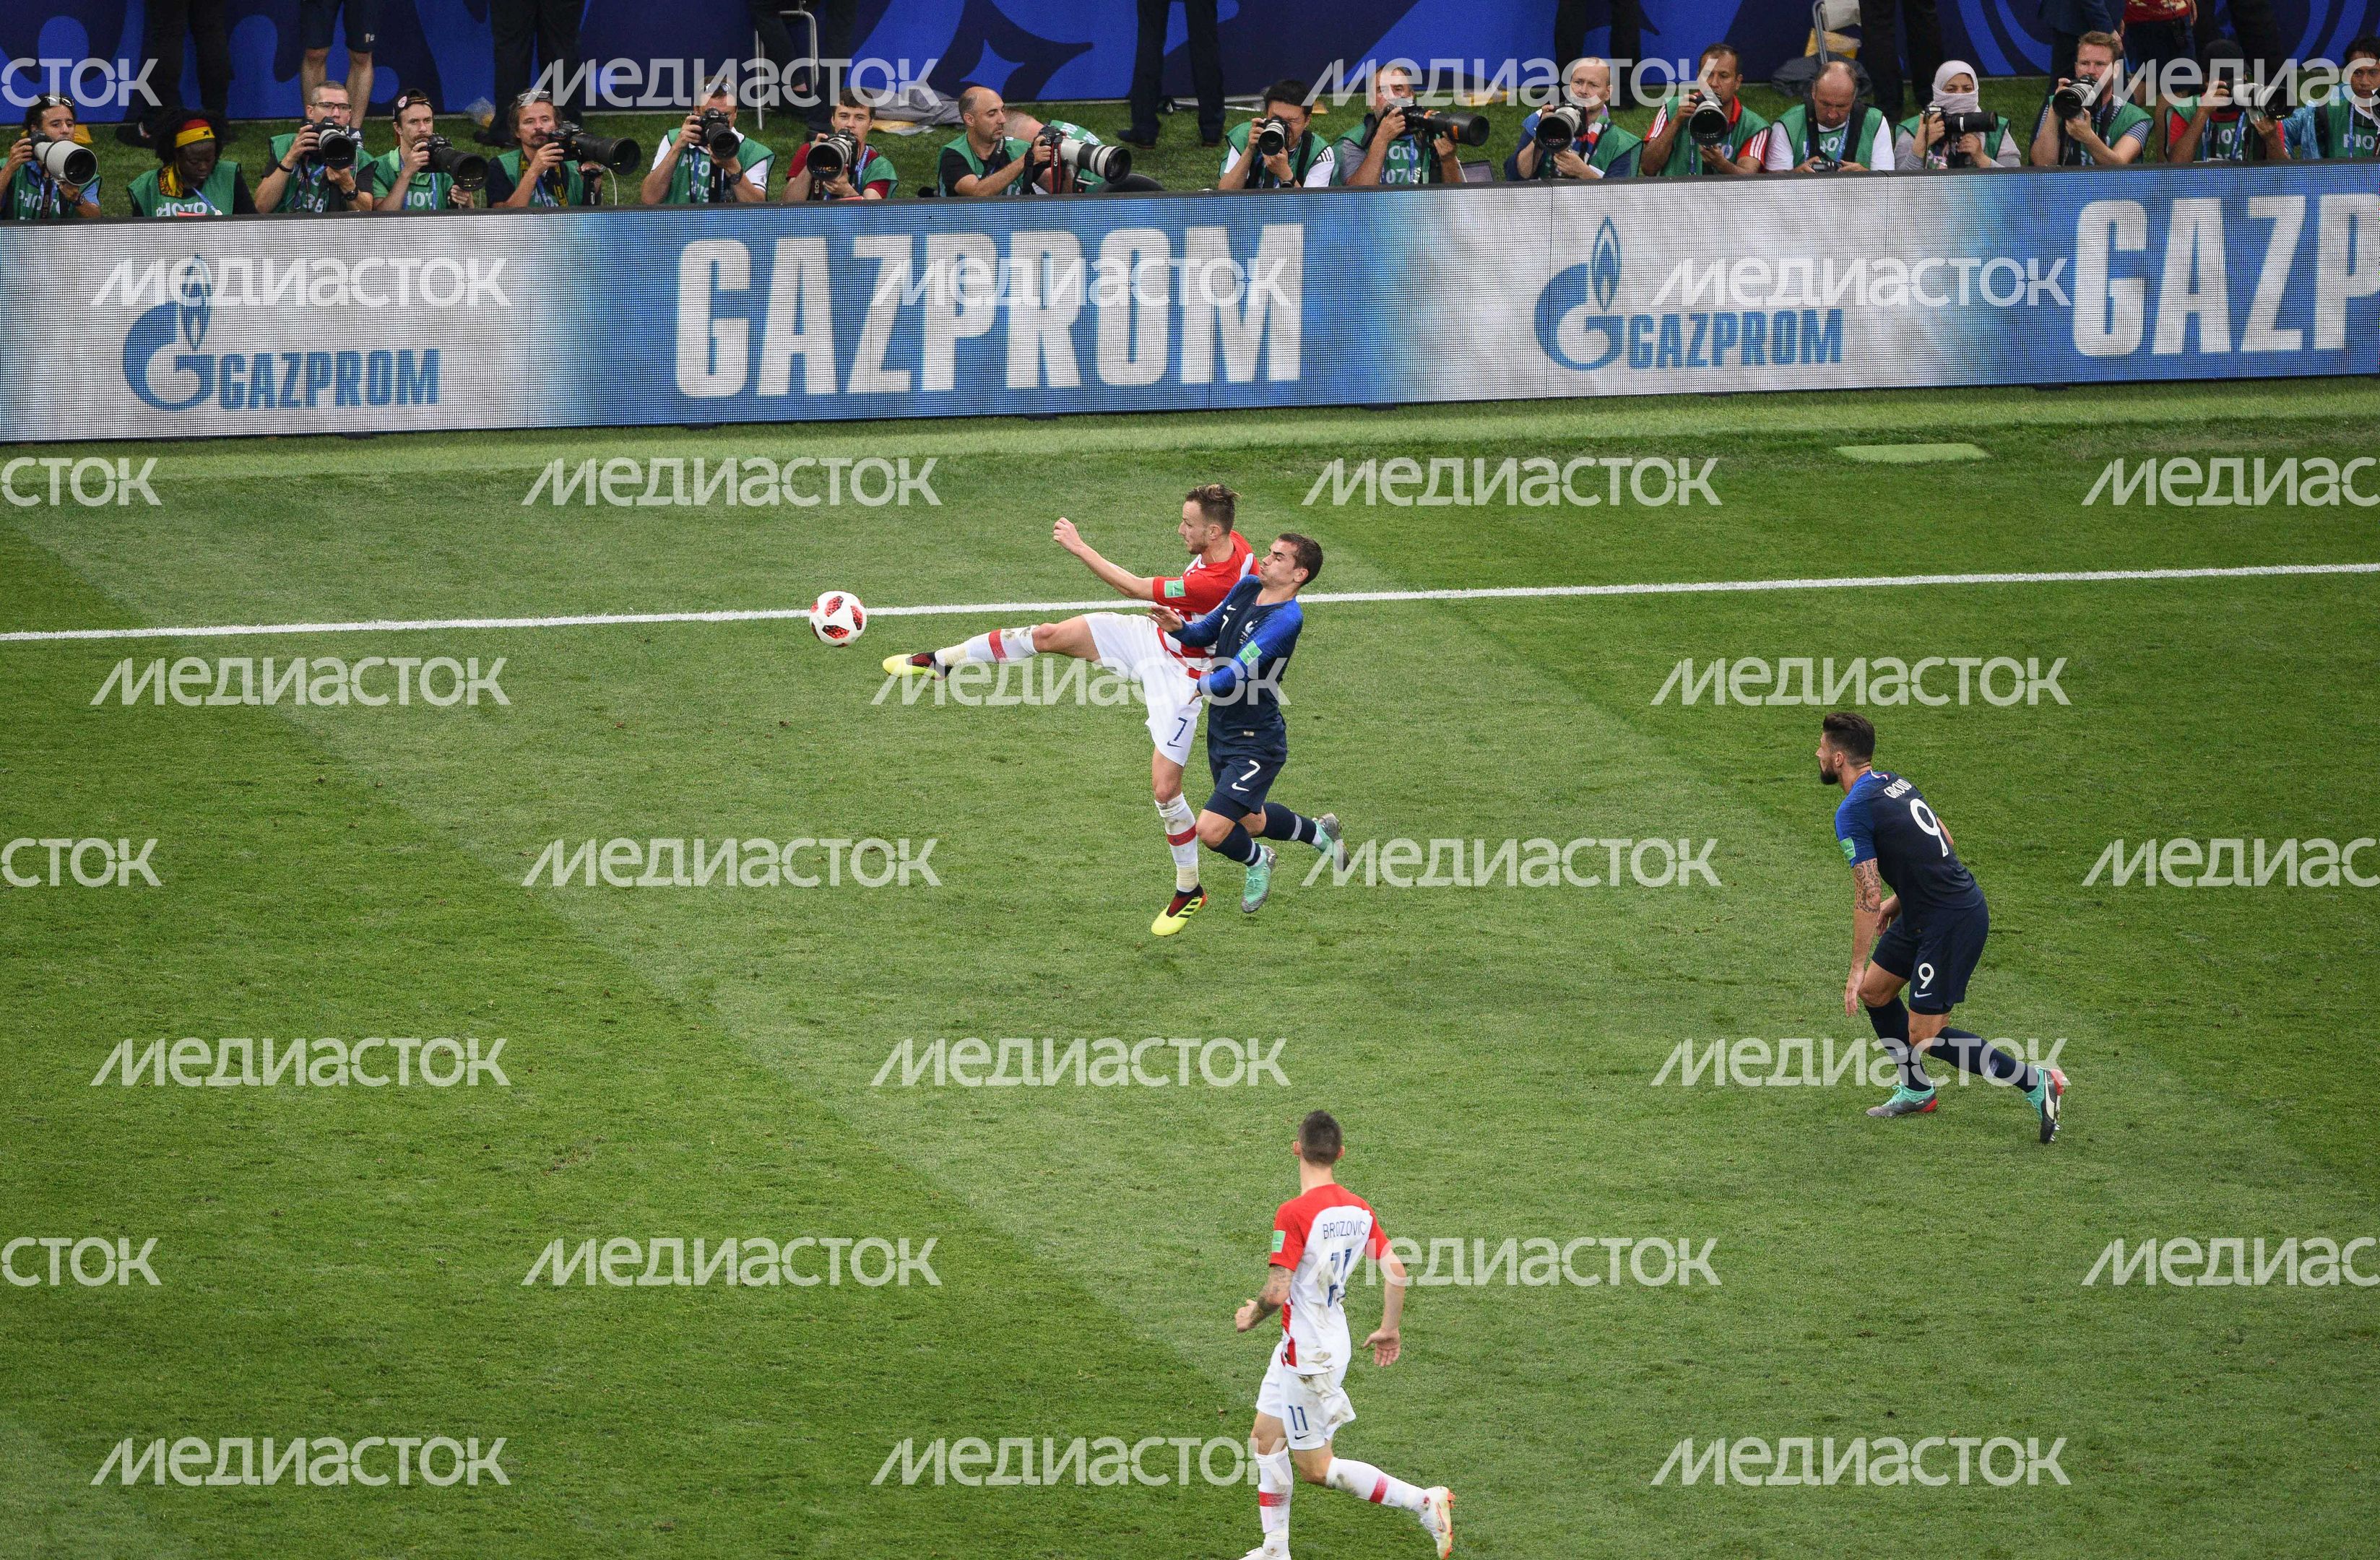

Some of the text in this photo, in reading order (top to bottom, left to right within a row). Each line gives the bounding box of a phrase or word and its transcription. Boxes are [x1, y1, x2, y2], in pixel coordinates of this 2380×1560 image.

[2074, 193, 2380, 356] GAZP
[675, 223, 1302, 398] GAZPROM
[1630, 308, 1844, 370] GAZPROM
[220, 349, 441, 410] GAZPROM
[1173, 716, 1188, 742] 7
[1239, 760, 1260, 781] 7
[1910, 798, 1949, 857] 9
[1918, 962, 1935, 989] 9
[1288, 1405, 1309, 1431] 11
